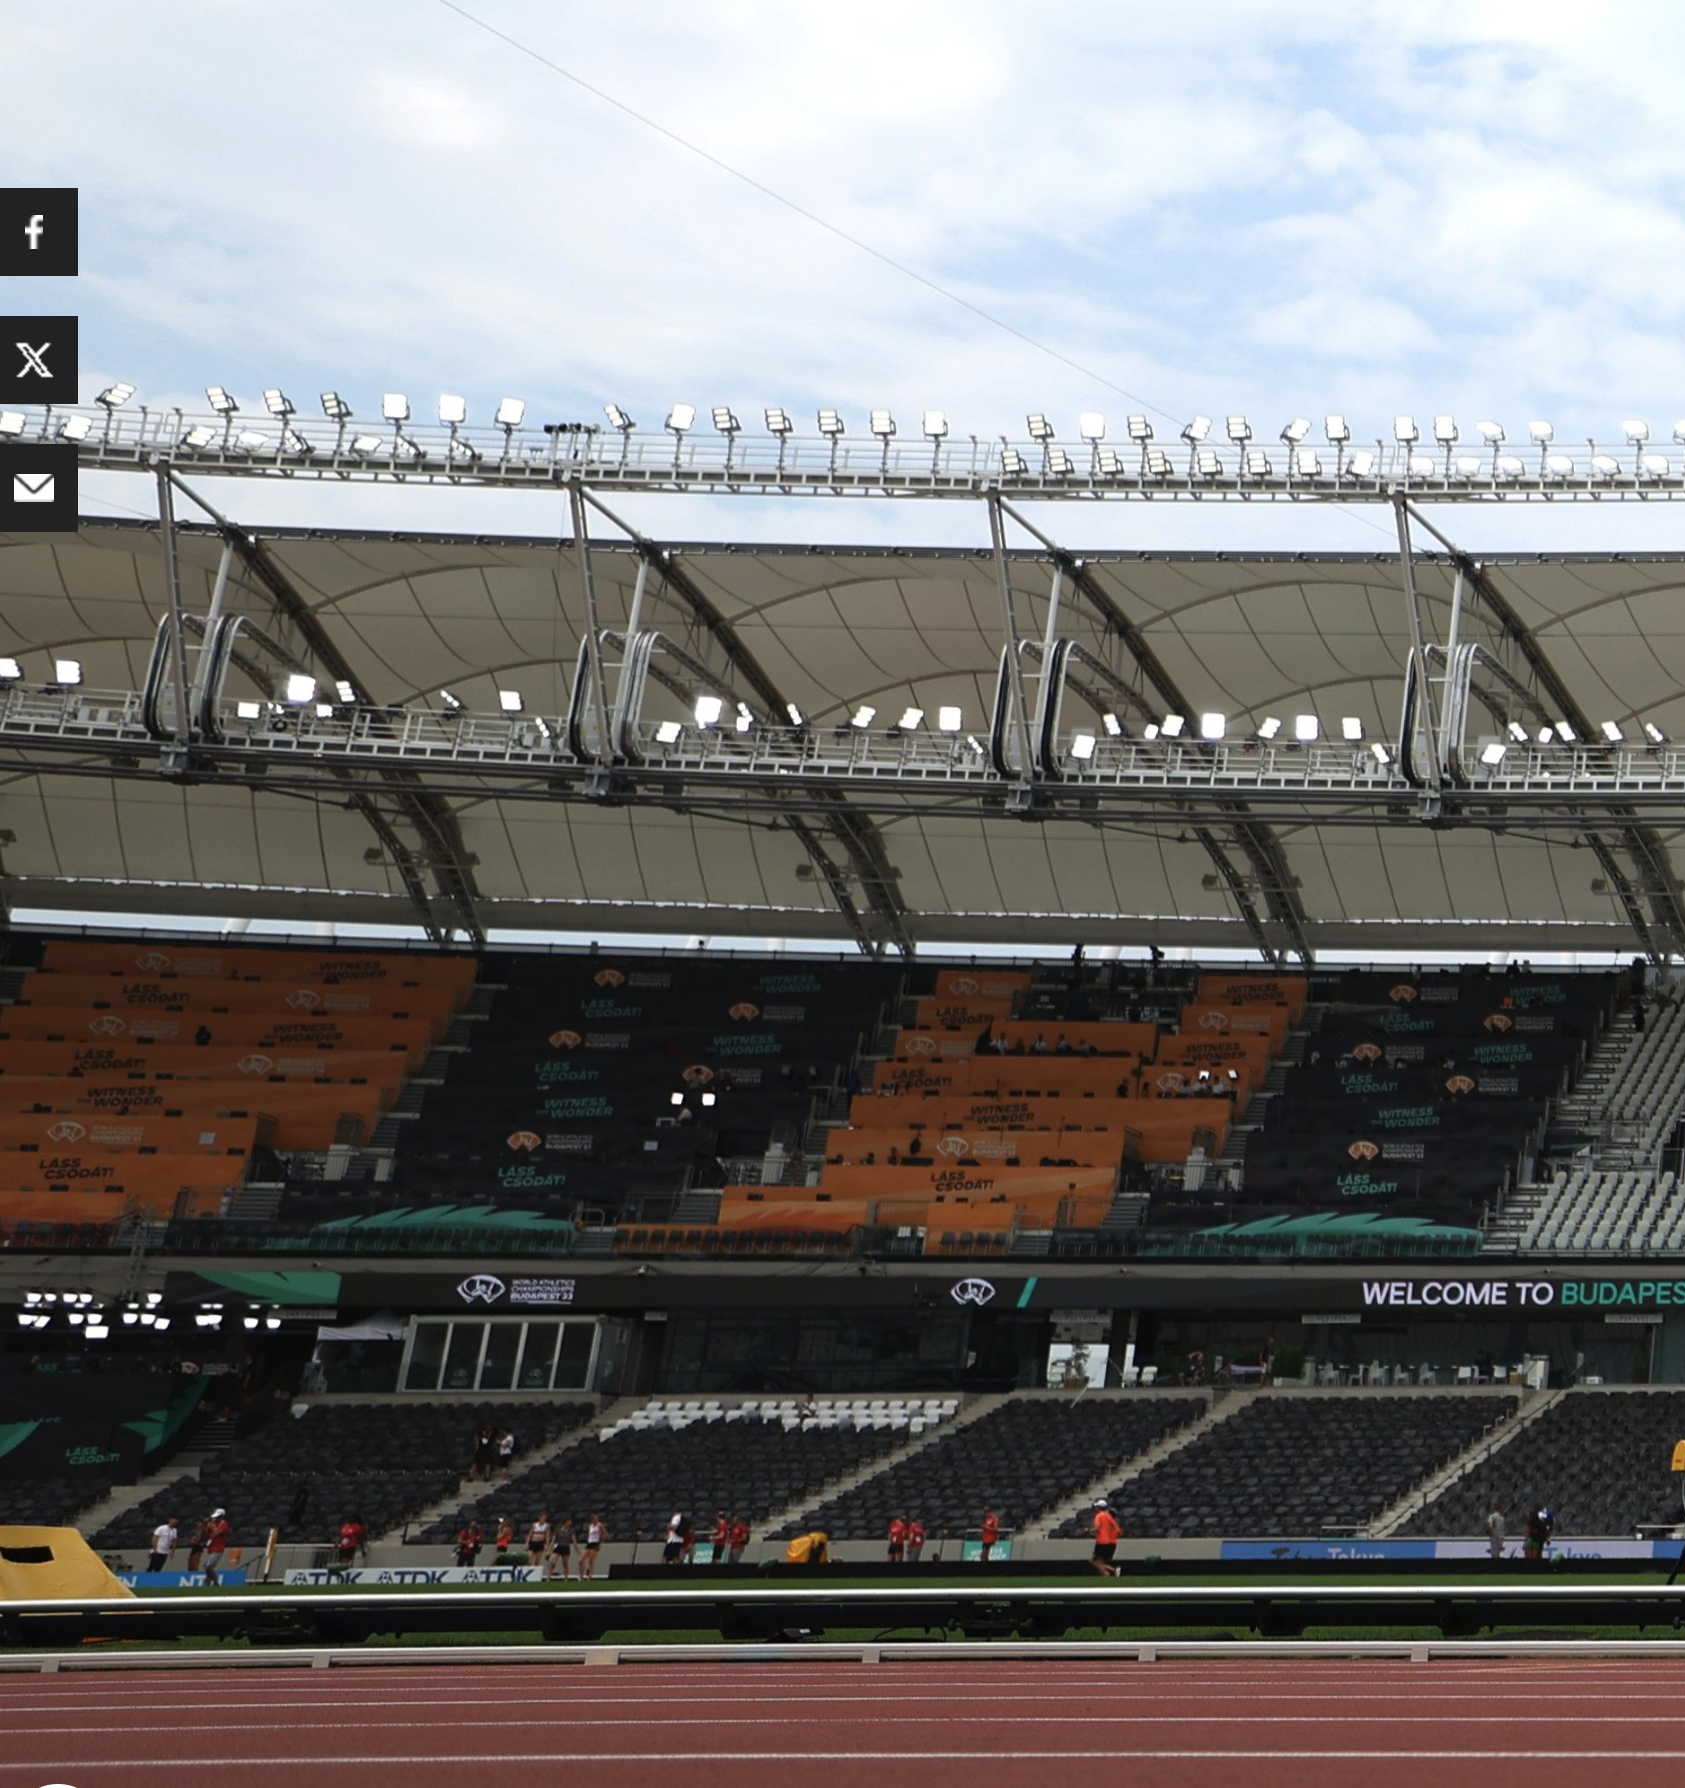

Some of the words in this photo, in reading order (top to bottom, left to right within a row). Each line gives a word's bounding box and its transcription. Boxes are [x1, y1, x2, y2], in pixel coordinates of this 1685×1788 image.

[510, 1292, 560, 1300] BUDAPEST
[561, 1292, 574, 1300] 23
[1362, 1281, 1508, 1306] WELCOME
[1515, 1281, 1554, 1306] TO
[309, 1571, 364, 1586] TDK
[394, 1570, 448, 1585] TDK
[480, 1569, 535, 1584] TDK
